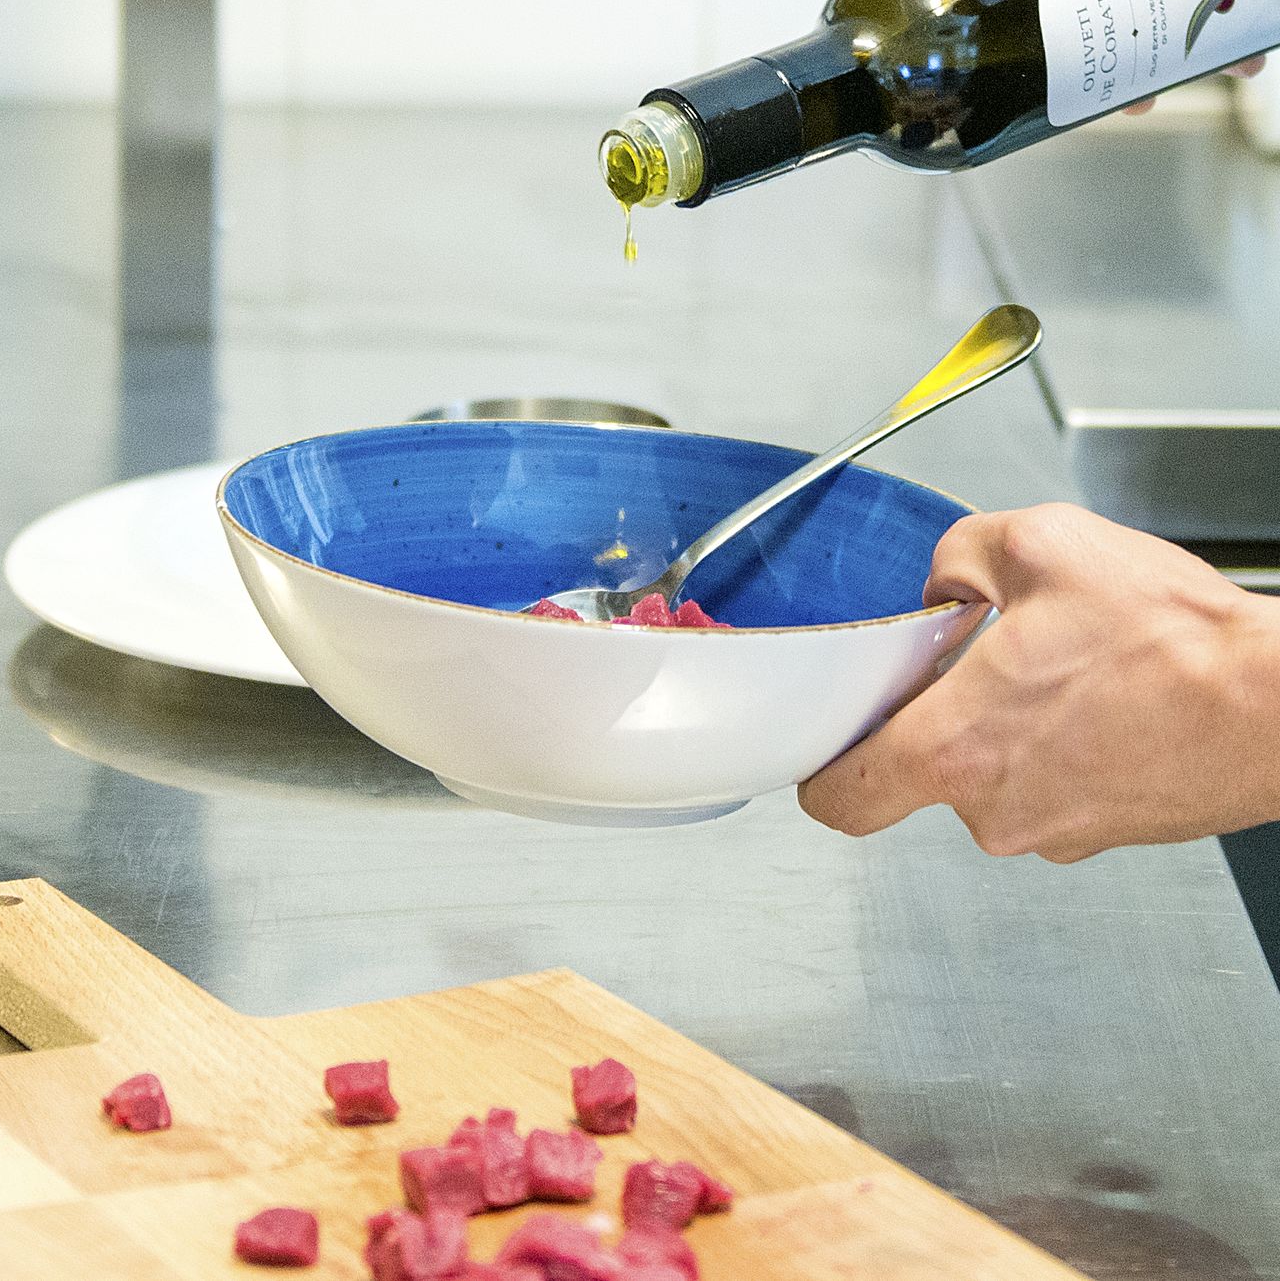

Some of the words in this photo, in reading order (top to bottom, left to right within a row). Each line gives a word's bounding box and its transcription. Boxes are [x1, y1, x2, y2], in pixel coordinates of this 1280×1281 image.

[1159, 0, 1168, 31] OLIVA
[1077, 7, 1096, 92] OLIVETI
[1161, 36, 1168, 45] DI
[1150, 55, 1158, 77] OLIO
[1100, 78, 1116, 102] DE
